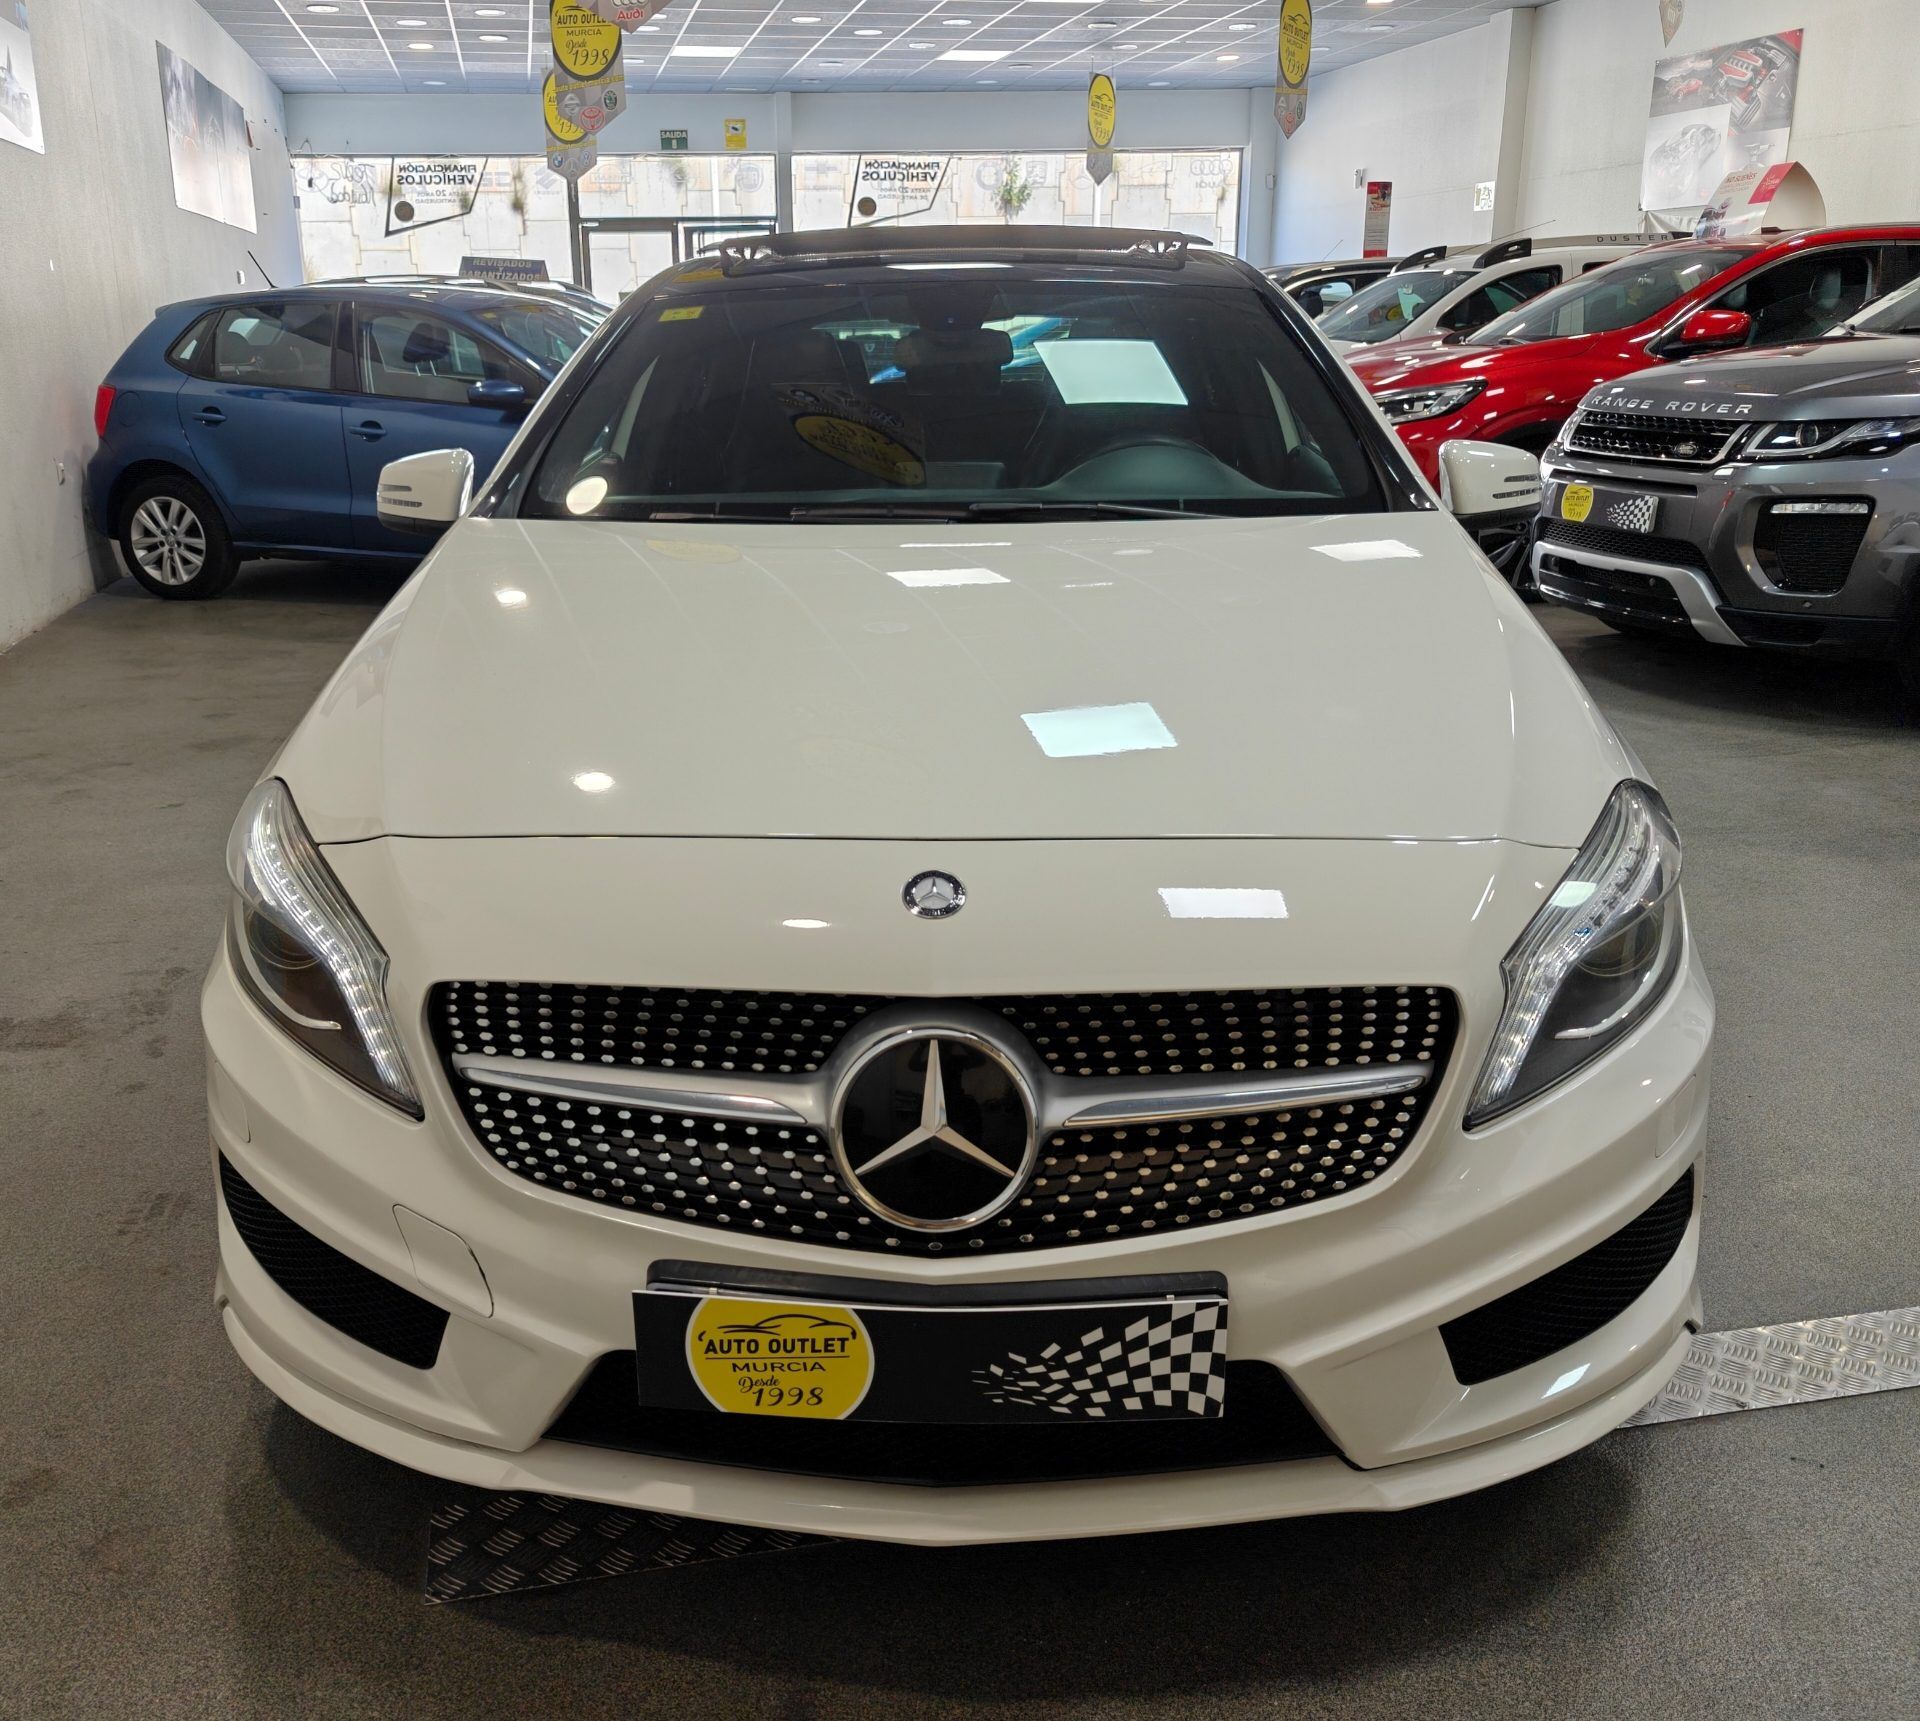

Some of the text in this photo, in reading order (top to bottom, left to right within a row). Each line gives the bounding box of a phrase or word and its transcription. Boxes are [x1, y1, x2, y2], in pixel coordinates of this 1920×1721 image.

[556, 12, 607, 25] AUTO OUTLE
[617, 9, 644, 20] Audi
[566, 28, 602, 37] MURCIA
[572, 48, 610, 66] 1998
[660, 131, 687, 139] SALIDA
[1596, 234, 1668, 243] DUSTER
[472, 258, 532, 268] REVISADOS
[1591, 396, 1753, 414] RANGE ROVER
[704, 1337, 850, 1355] AUTO OUTLET
[732, 1361, 826, 1373] MURCIA
[738, 1374, 780, 1393] Desde
[752, 1386, 824, 1407] 1998
